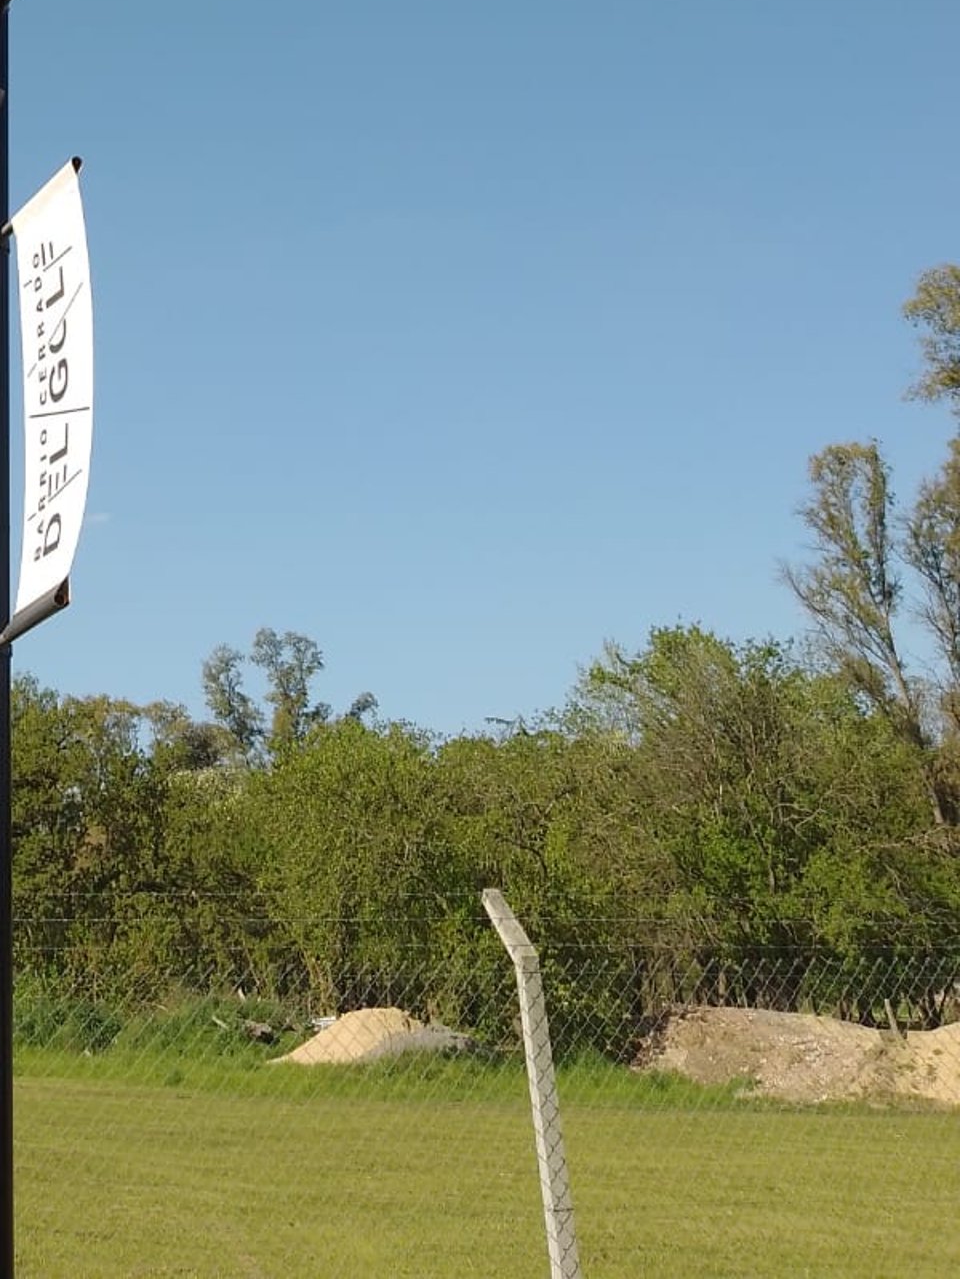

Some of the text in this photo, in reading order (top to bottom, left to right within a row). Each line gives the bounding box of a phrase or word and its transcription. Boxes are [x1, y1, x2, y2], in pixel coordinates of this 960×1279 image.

[32, 253, 47, 562] BARRIO CERRADO
[42, 241, 83, 557] DEL GOLF
